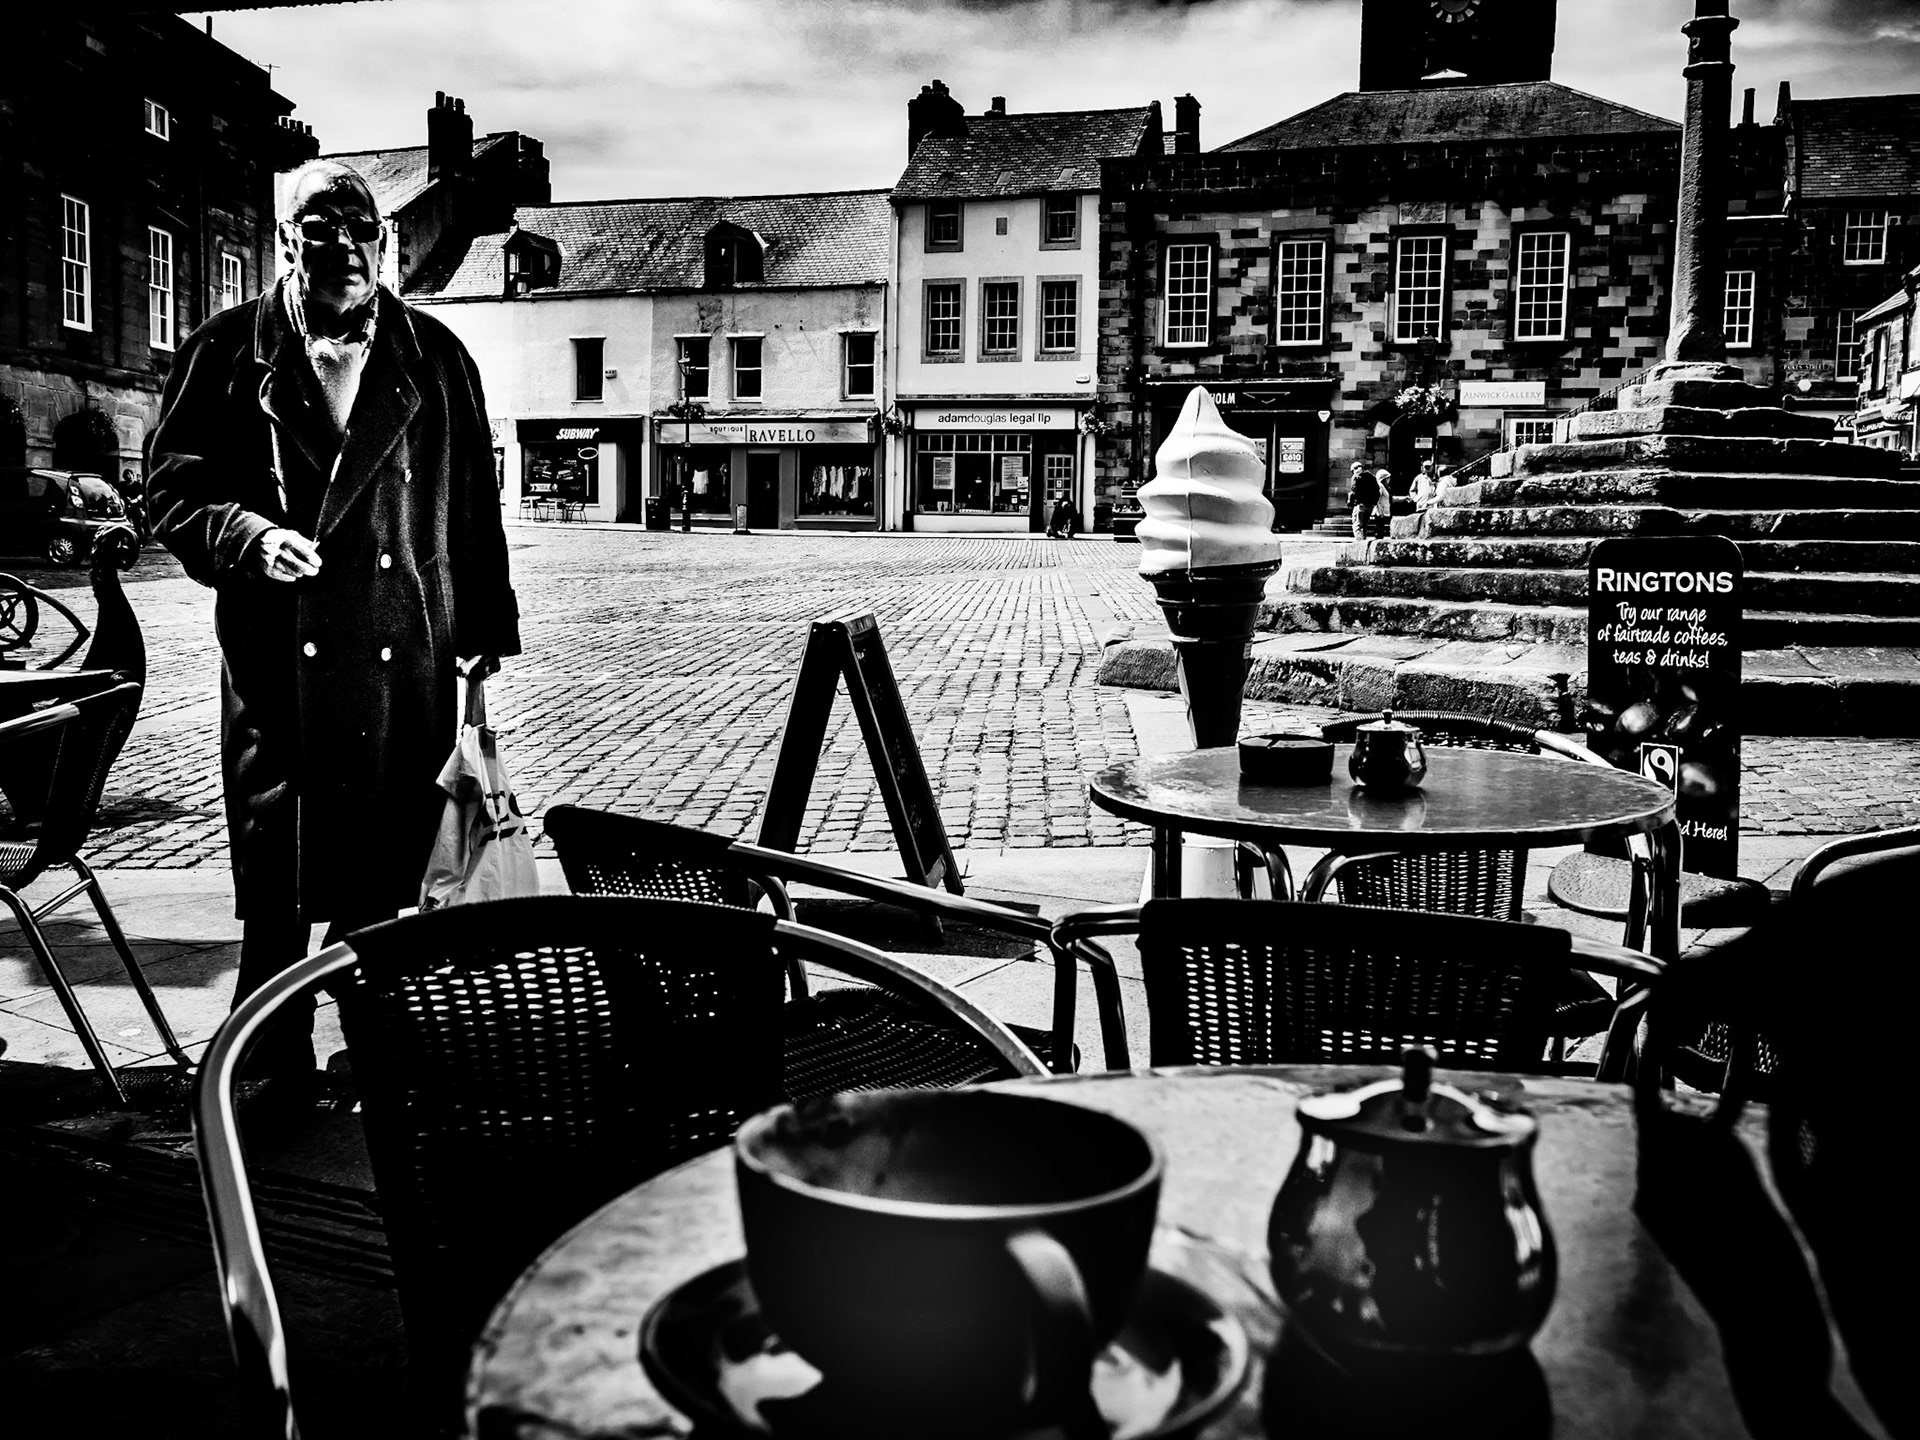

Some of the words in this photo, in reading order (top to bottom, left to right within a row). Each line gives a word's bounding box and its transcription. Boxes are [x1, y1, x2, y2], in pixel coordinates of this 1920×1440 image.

[1463, 391, 1501, 399] ALNWICK
[1502, 391, 1542, 401] GALLERY
[937, 413, 1007, 425] adamdouglas
[1009, 413, 1035, 425] legal
[1038, 413, 1051, 425] llp
[556, 428, 600, 440] SUBWAY
[749, 429, 816, 442] RAVELLO
[1616, 601, 1637, 627] Try
[1640, 607, 1664, 621] our
[1667, 607, 1707, 630] range
[1597, 623, 1613, 642] of
[1613, 623, 1671, 644] fairtrade
[1673, 626, 1728, 647] coffees,
[1613, 648, 1642, 664] teas
[1645, 648, 1657, 665] &
[1660, 648, 1710, 668] drinks!
[1692, 820, 1728, 841] Here!
